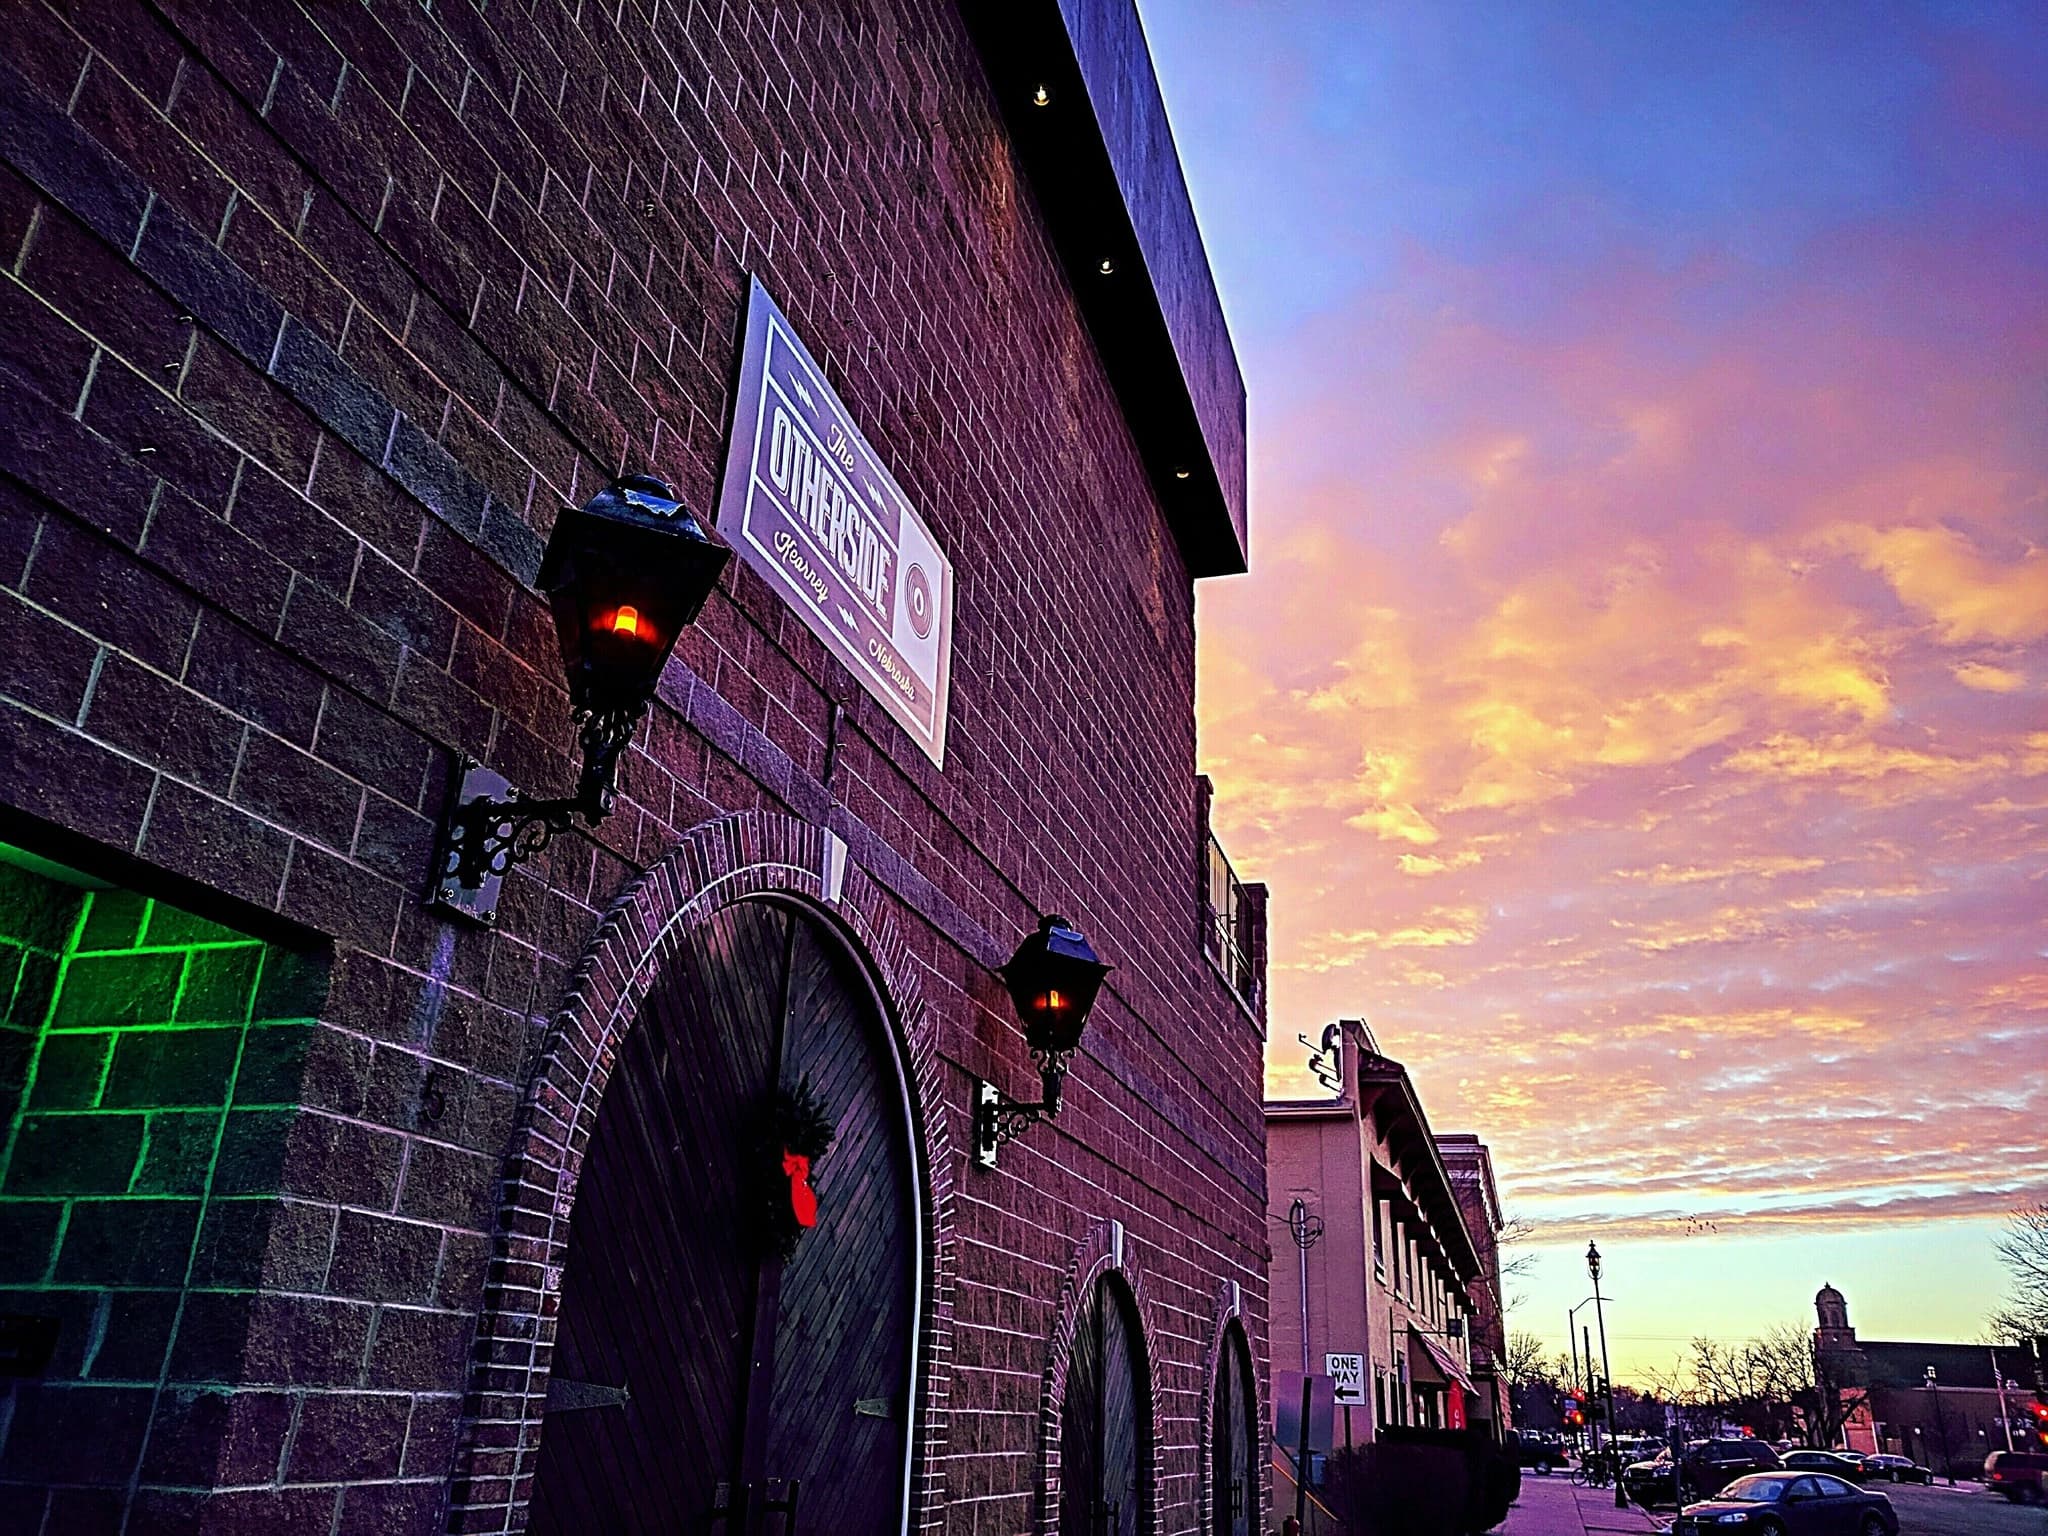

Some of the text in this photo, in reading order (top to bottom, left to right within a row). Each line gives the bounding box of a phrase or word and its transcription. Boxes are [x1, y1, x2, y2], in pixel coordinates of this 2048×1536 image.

[826, 423, 855, 473] The
[769, 406, 892, 621] OTHERSIDE
[774, 531, 915, 701] Kearney Nebraska
[1331, 1356, 1358, 1370] ONE
[1331, 1370, 1359, 1384] WAY
